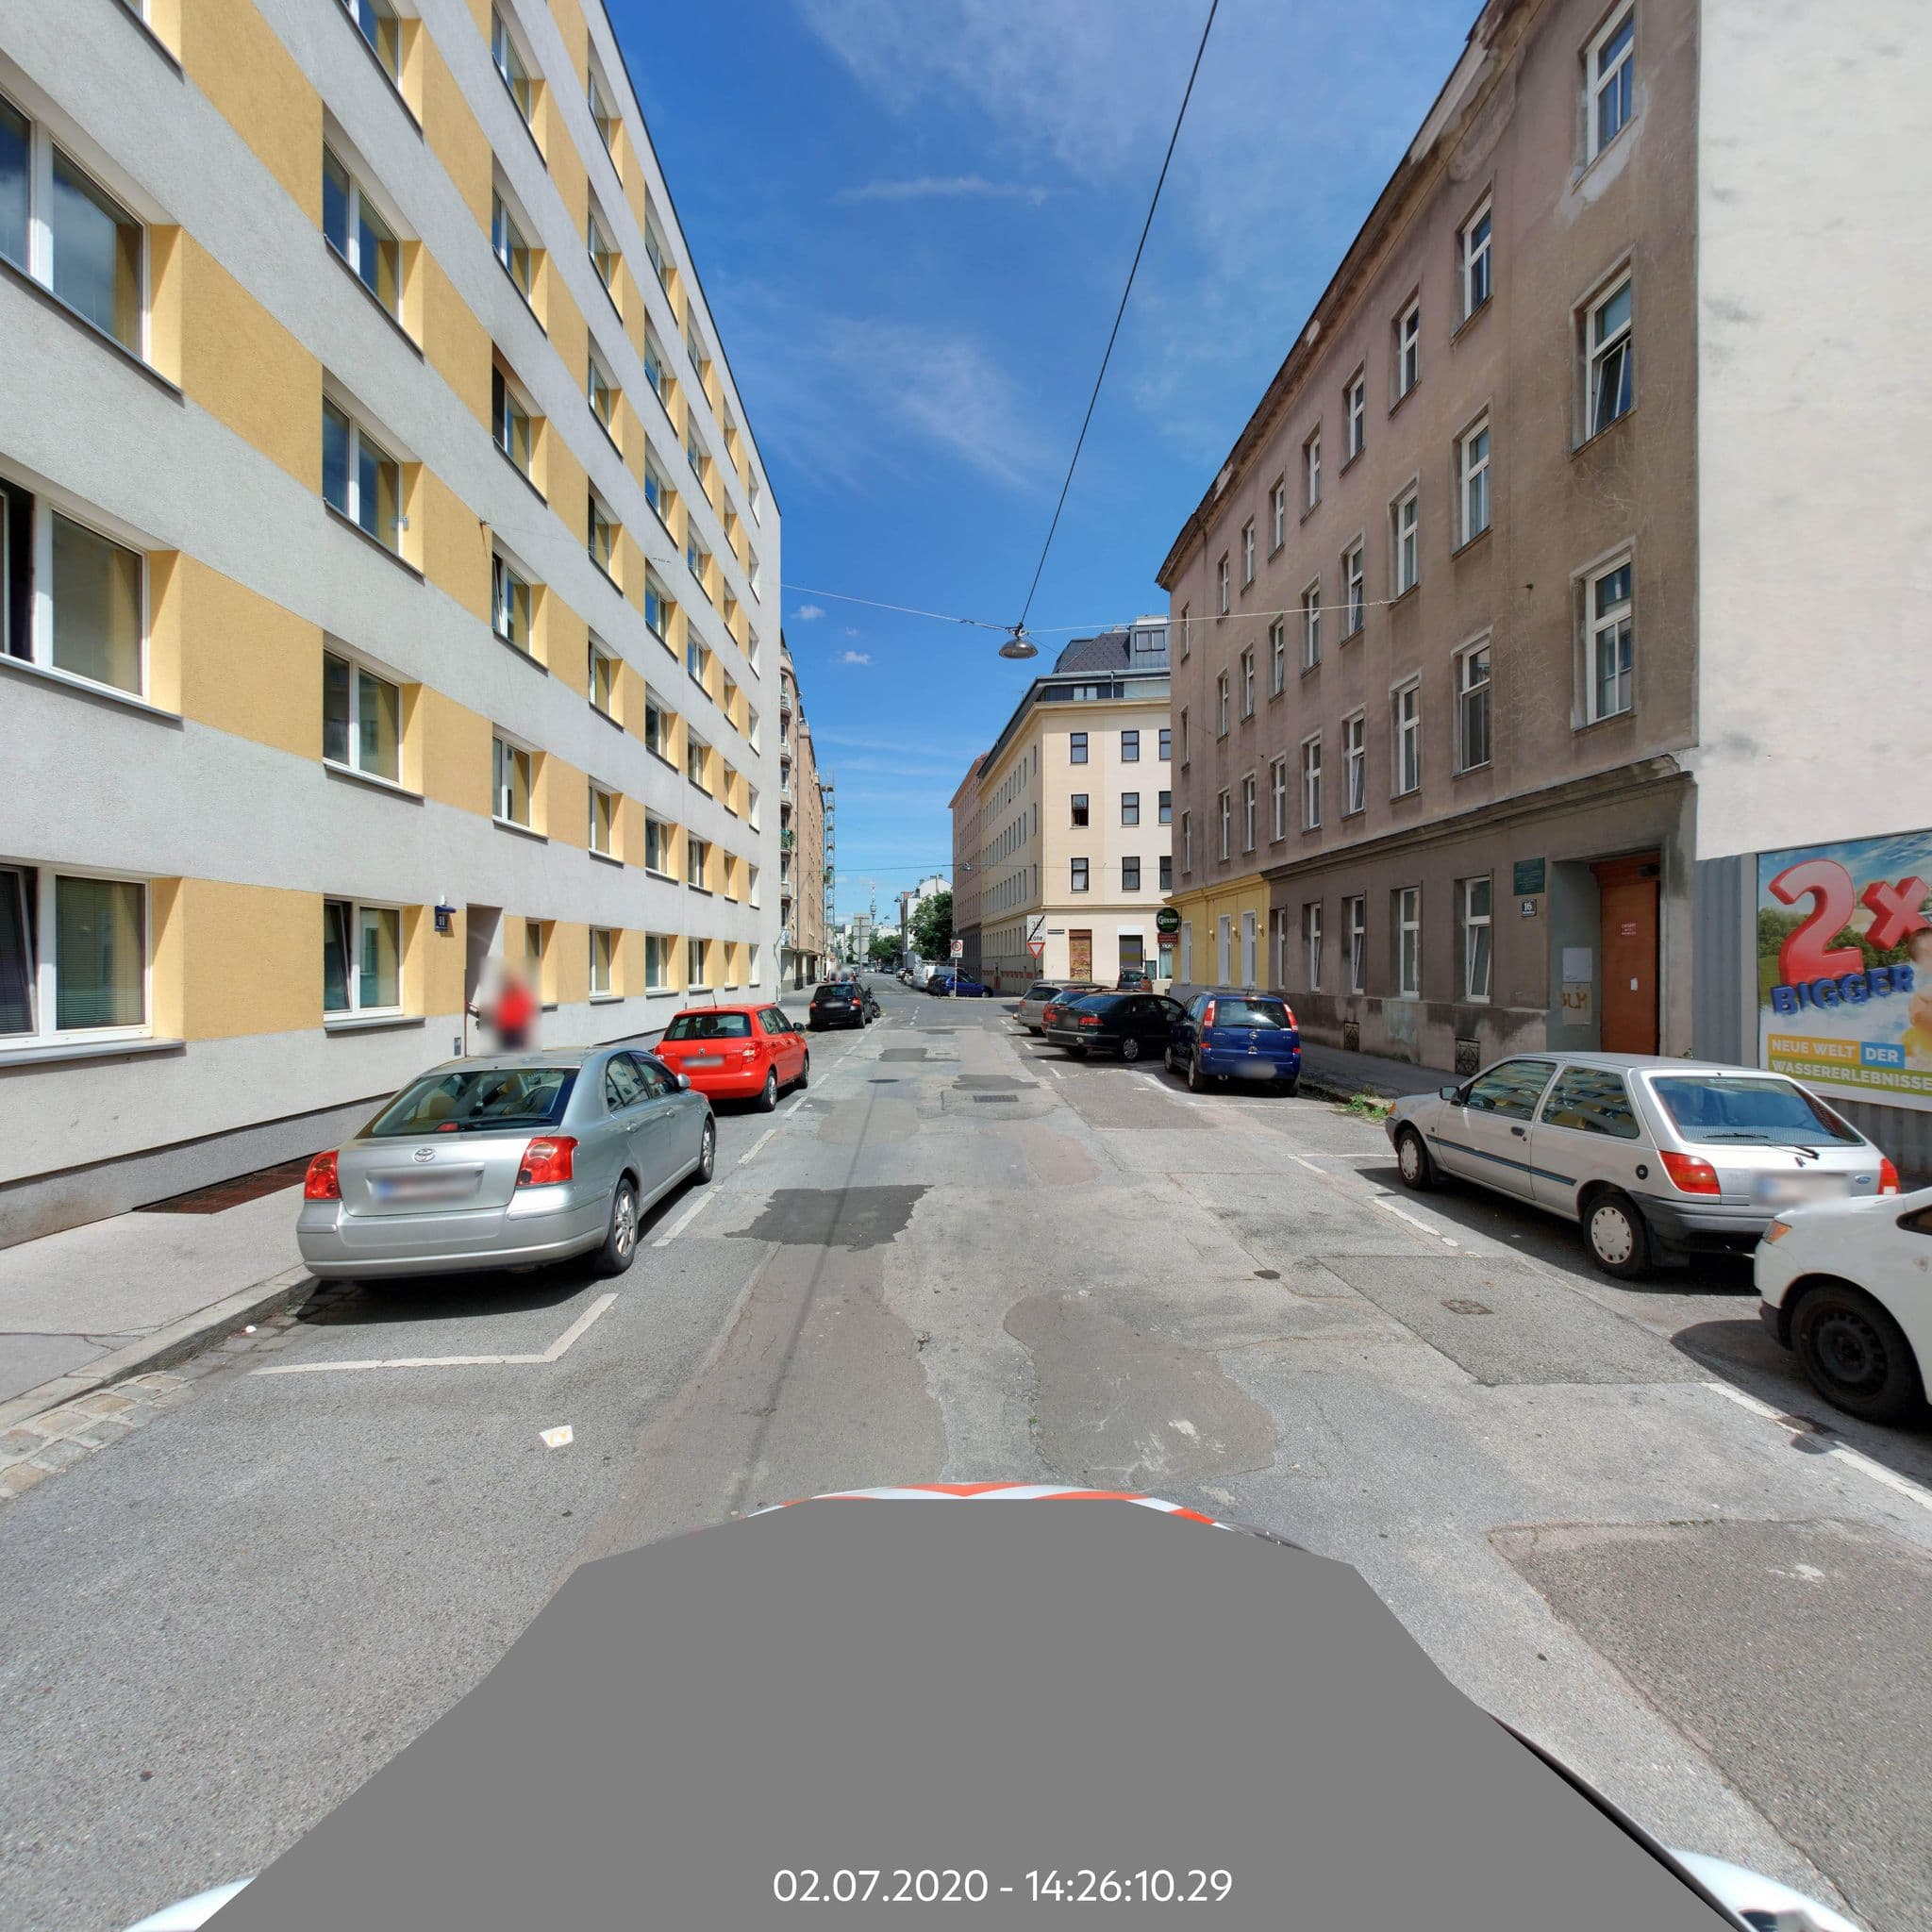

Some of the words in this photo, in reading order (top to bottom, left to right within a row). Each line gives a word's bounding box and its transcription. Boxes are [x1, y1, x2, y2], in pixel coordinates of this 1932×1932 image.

[1524, 902, 1532, 911] 16
[1771, 965, 1915, 1016] BIGGER
[1772, 1040, 1809, 1054] NEUE
[1812, 1042, 1856, 1058] WELT
[1865, 1047, 1899, 1063] DER
[1773, 1060, 1932, 1091] WASSERERLEBNISSE
